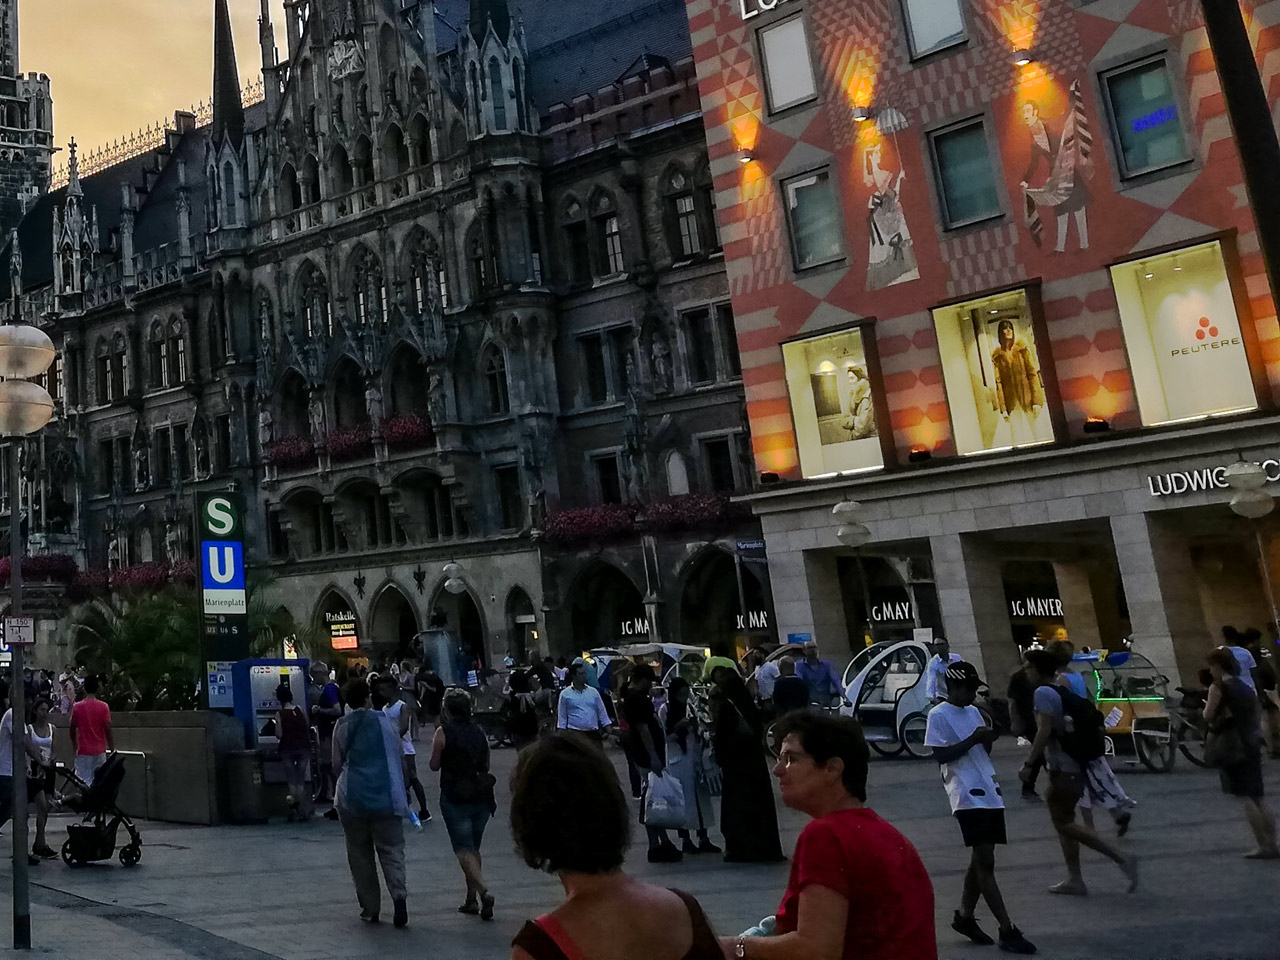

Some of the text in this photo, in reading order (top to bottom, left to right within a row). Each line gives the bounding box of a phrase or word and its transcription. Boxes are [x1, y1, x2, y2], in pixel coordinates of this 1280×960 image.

[1171, 337, 1241, 357] PEUTERE
[207, 497, 234, 535] S
[209, 547, 235, 584] U
[205, 598, 245, 608] Marienplatz
[882, 602, 914, 621] MAY
[1026, 597, 1064, 617] MAYER
